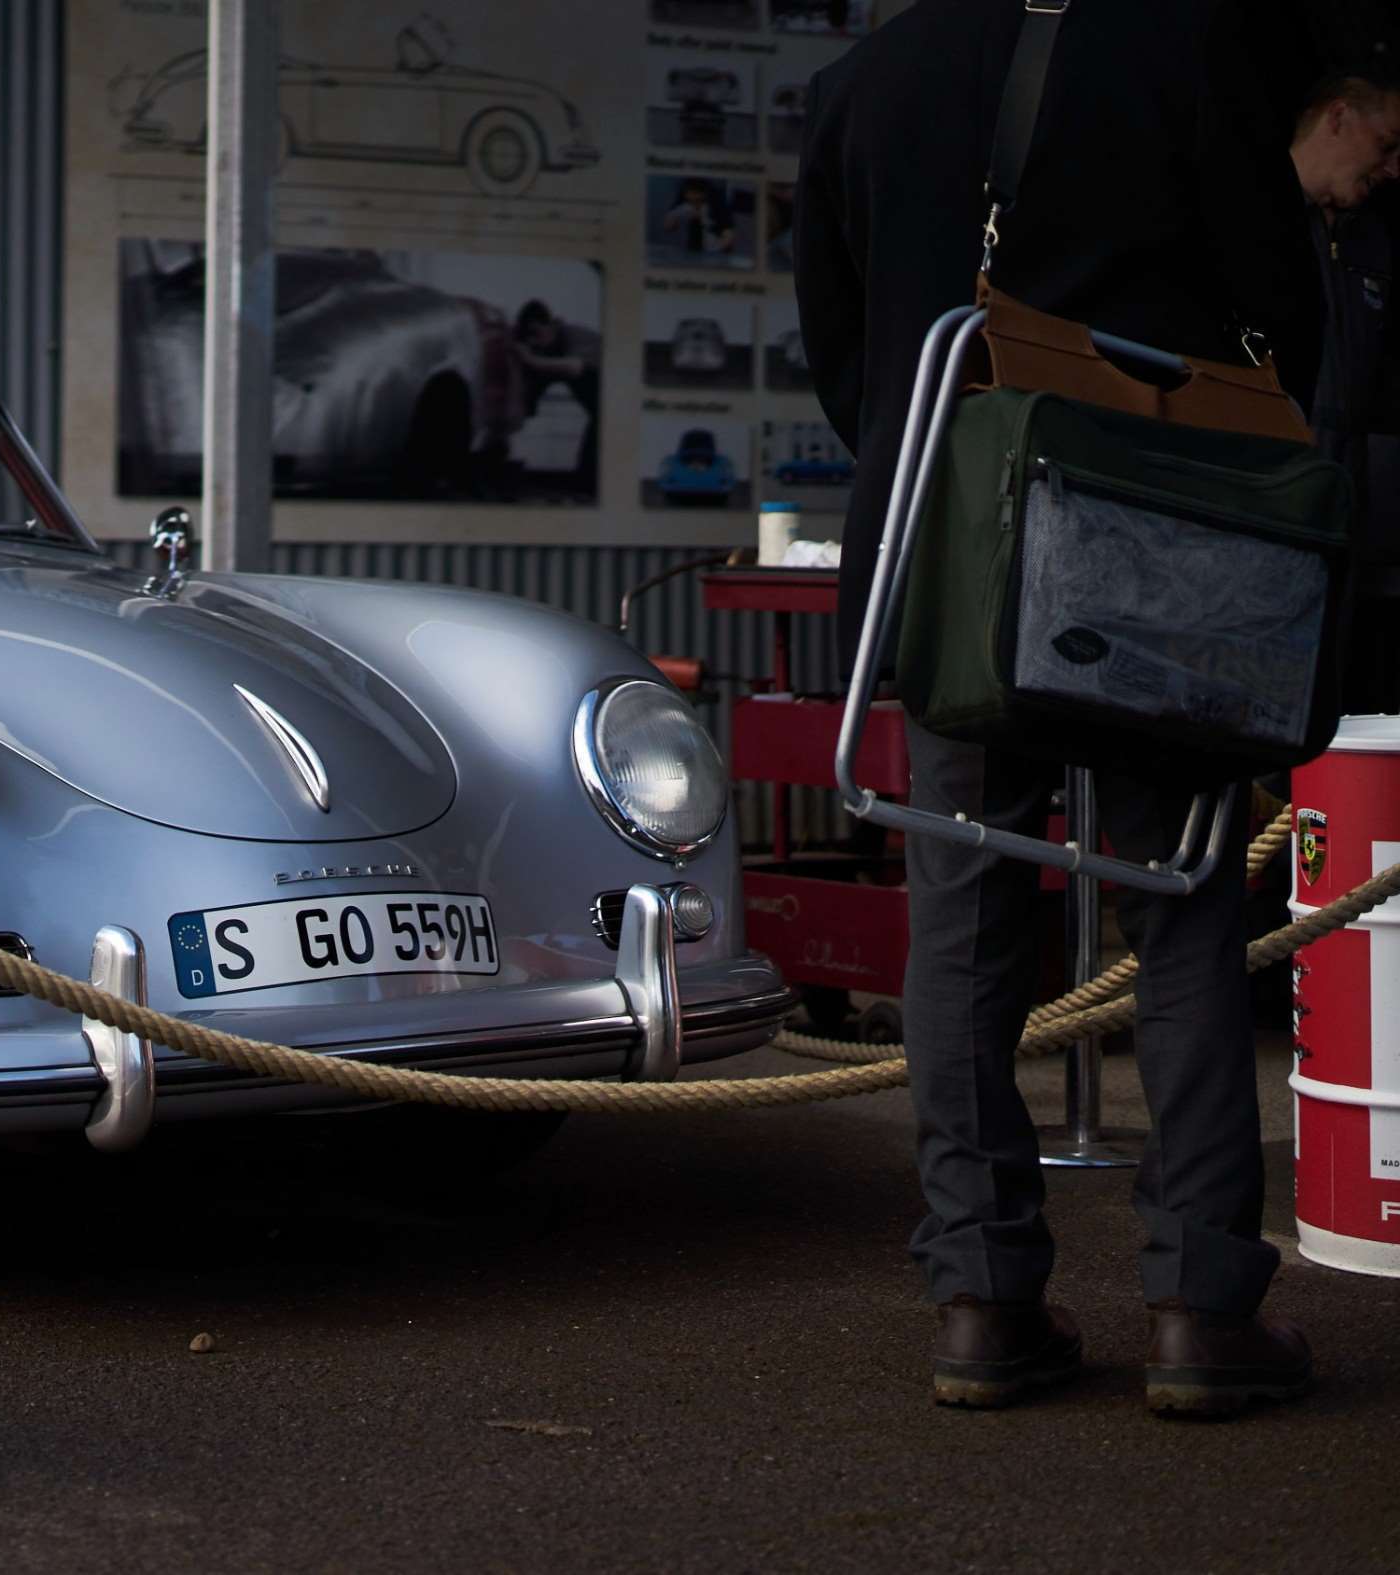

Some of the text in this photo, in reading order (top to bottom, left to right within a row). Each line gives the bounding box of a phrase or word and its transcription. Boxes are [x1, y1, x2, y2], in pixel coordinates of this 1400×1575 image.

[274, 864, 419, 883] PORSCHE
[214, 903, 496, 980] S GO 559H
[192, 969, 205, 986] D
[1381, 1159, 1400, 1168] MAD
